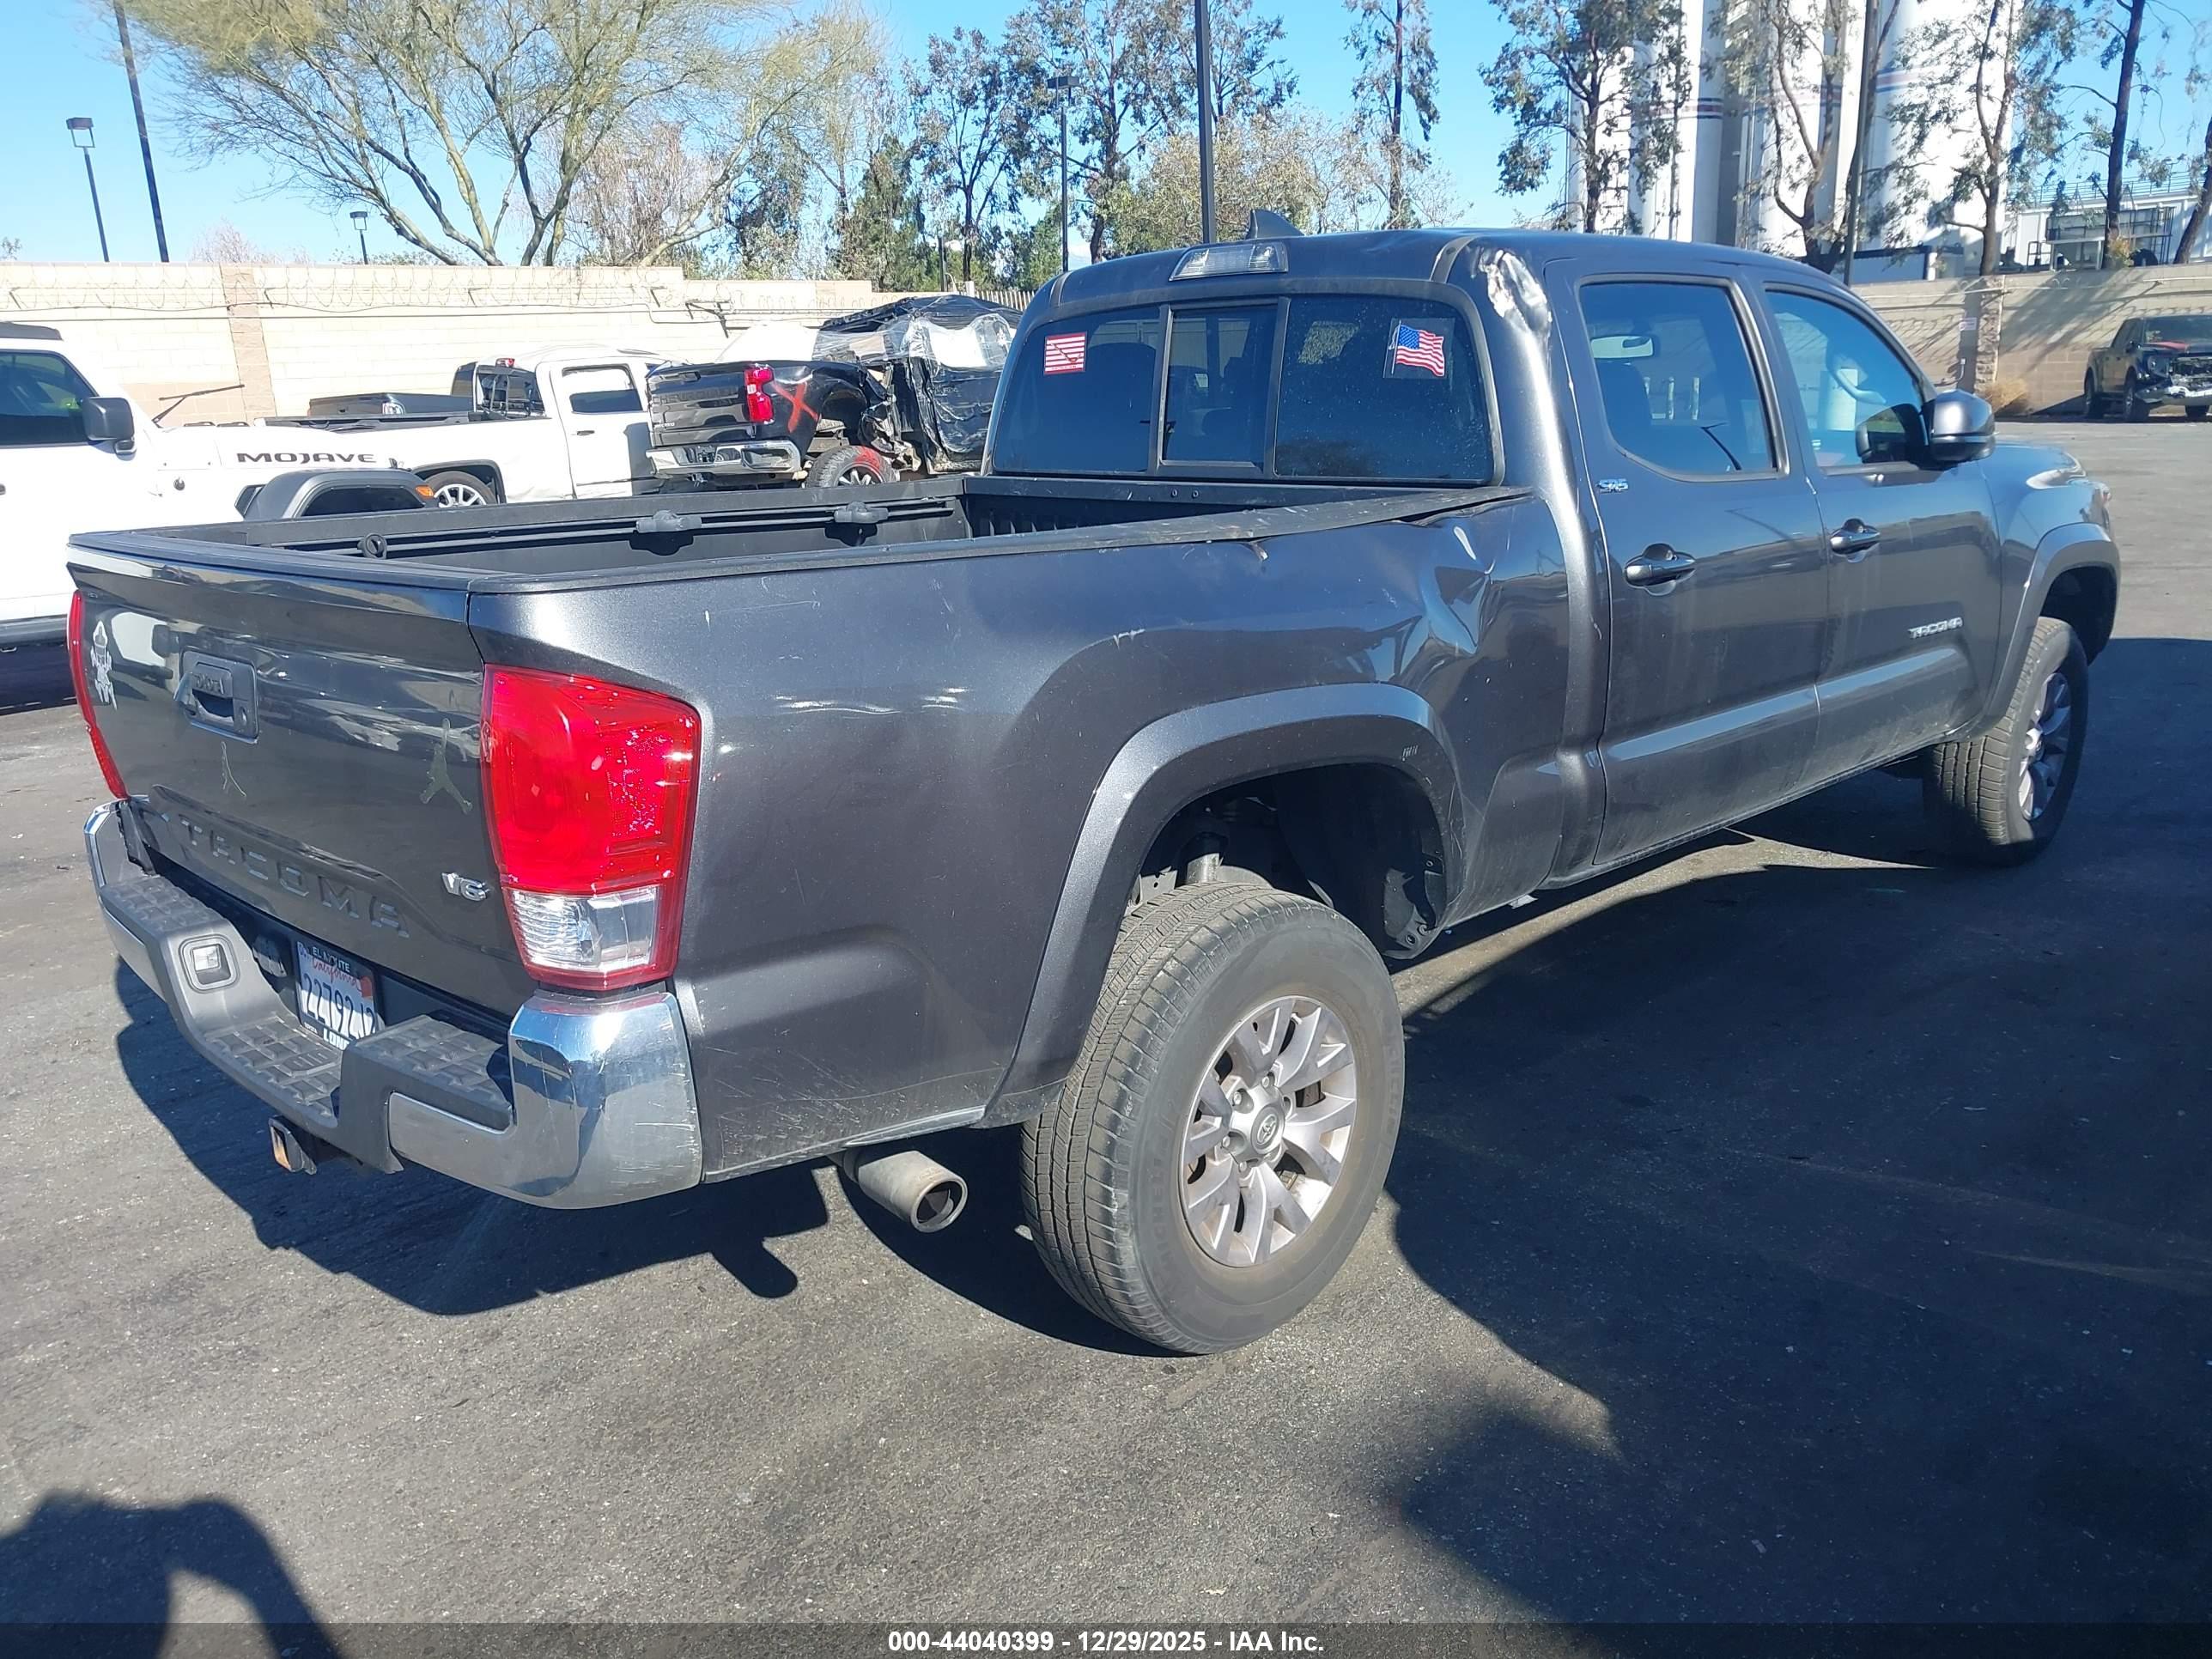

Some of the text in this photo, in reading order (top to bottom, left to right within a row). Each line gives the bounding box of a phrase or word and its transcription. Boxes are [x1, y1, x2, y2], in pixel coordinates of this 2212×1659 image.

[236, 453, 377, 465] MOJAVE
[179, 814, 410, 938] TACOMA
[441, 872, 487, 901] V6
